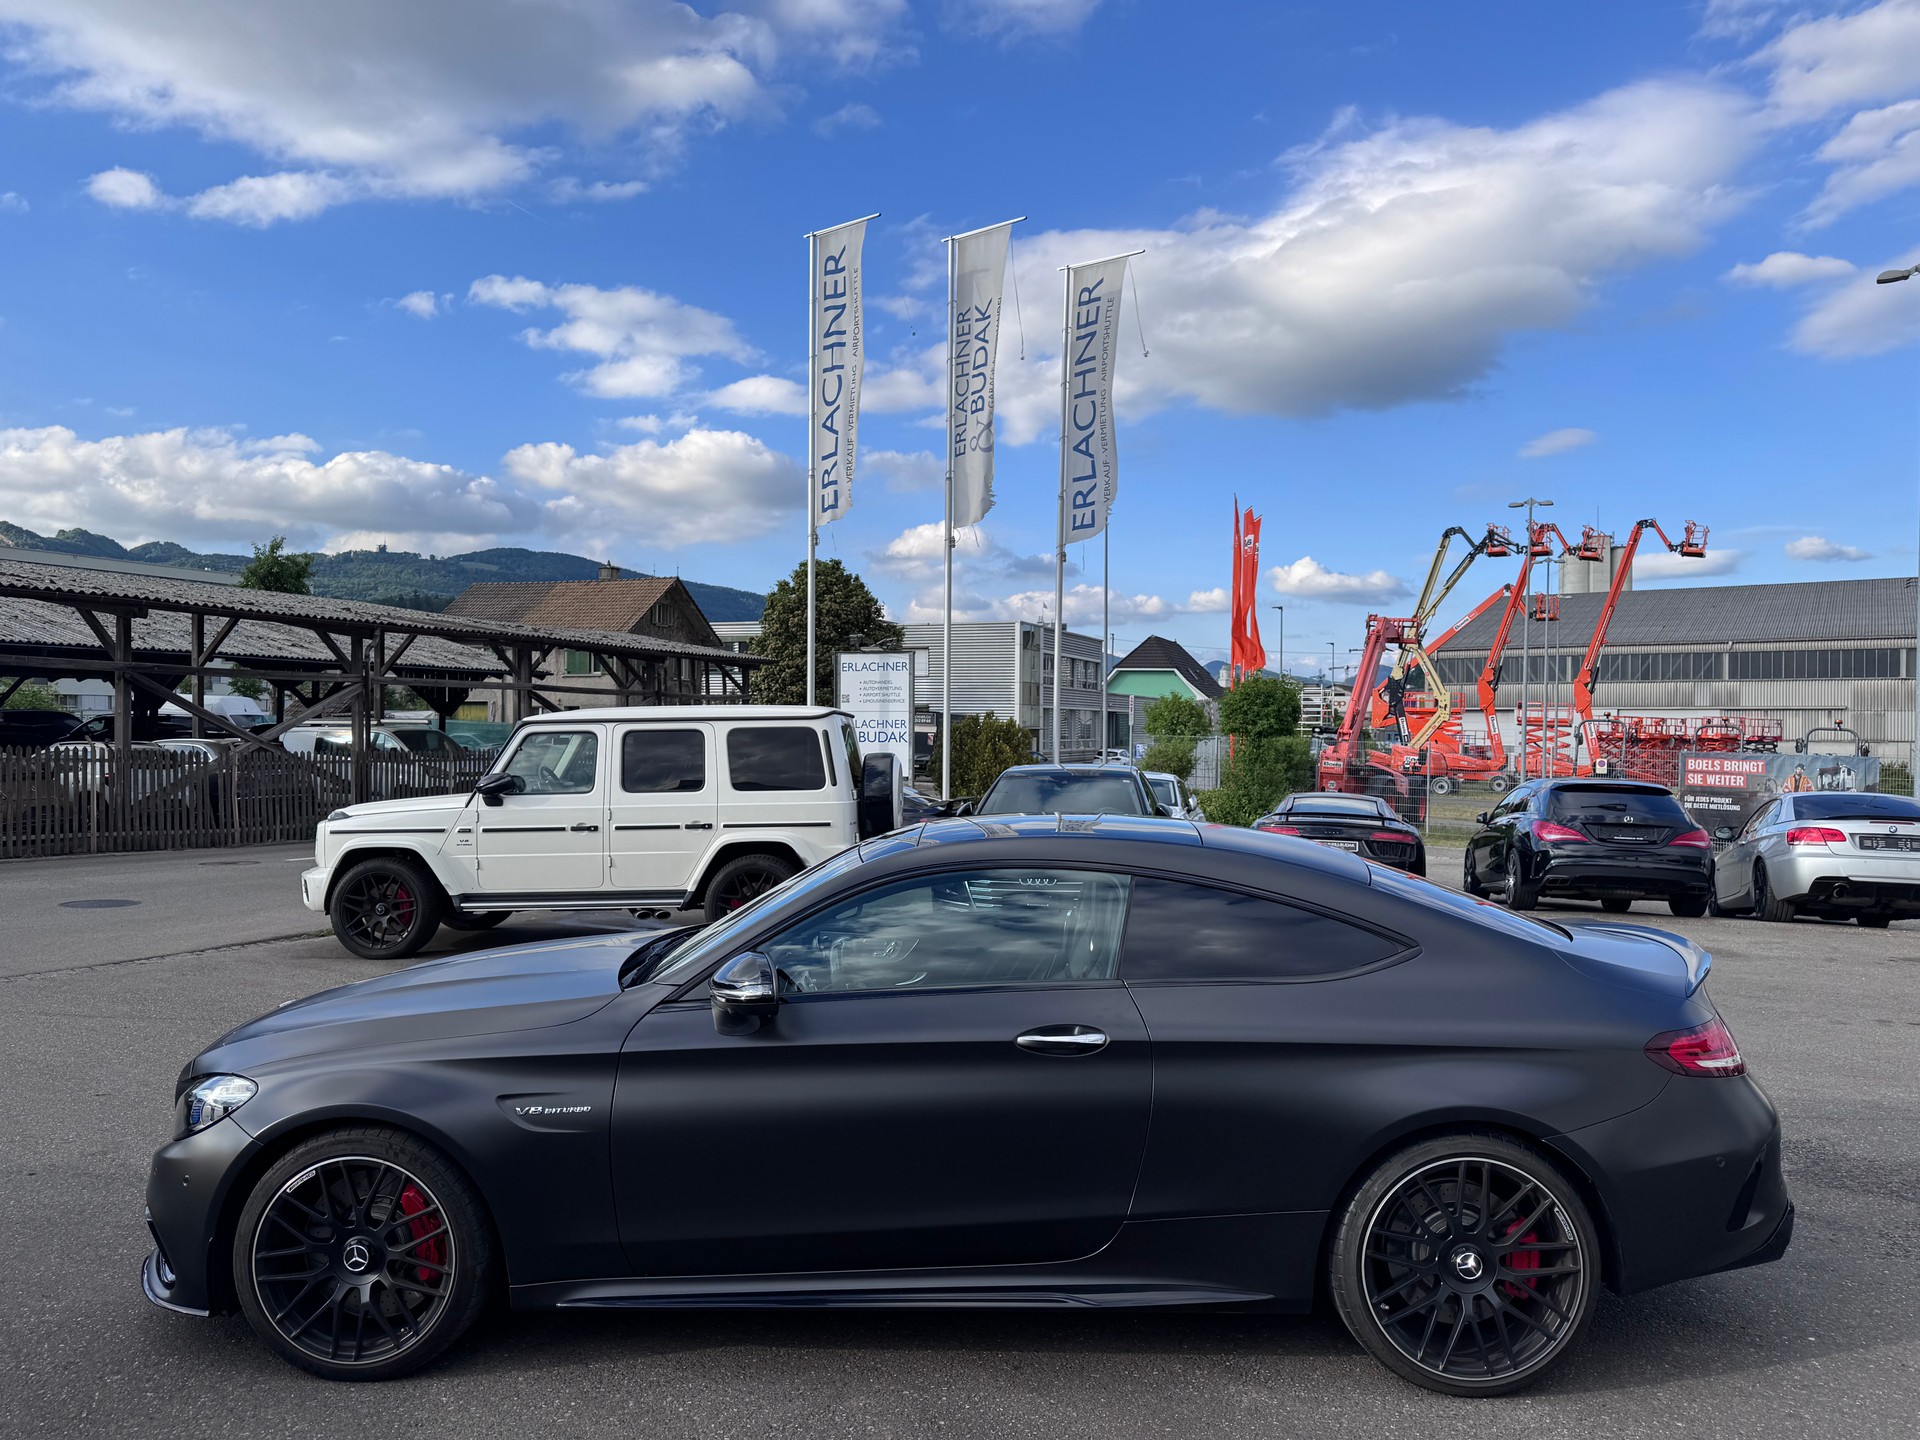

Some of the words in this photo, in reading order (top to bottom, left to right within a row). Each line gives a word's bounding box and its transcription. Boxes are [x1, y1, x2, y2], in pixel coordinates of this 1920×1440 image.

[851, 267, 860, 358] AIRPORTSHUTTLE
[970, 297, 993, 415] BUDAK
[1101, 297, 1114, 382] AIRPORTSHUTTLE
[821, 245, 847, 514] ERLACHNER
[848, 364, 858, 432] VERMIETUNG
[954, 307, 971, 458] ERLACHNER
[1071, 277, 1104, 532] ERLACHNER
[1099, 388, 1108, 453] VERMIETUNG
[846, 437, 855, 484] VERKAUF
[1102, 459, 1112, 503] VERKAUF
[841, 661, 908, 672] ERLACHNER
[855, 719, 907, 729] LACHNER
[858, 731, 908, 743] BUDAK
[1687, 773, 1703, 784] SIE
[1706, 774, 1744, 786] WEITER
[1688, 759, 1720, 771] BOELS
[1724, 760, 1763, 772] BRINGT
[1709, 803, 1740, 811] MIETLÖSUNG
[515, 1106, 543, 1115] V8
[544, 1106, 592, 1114] BITURBO
